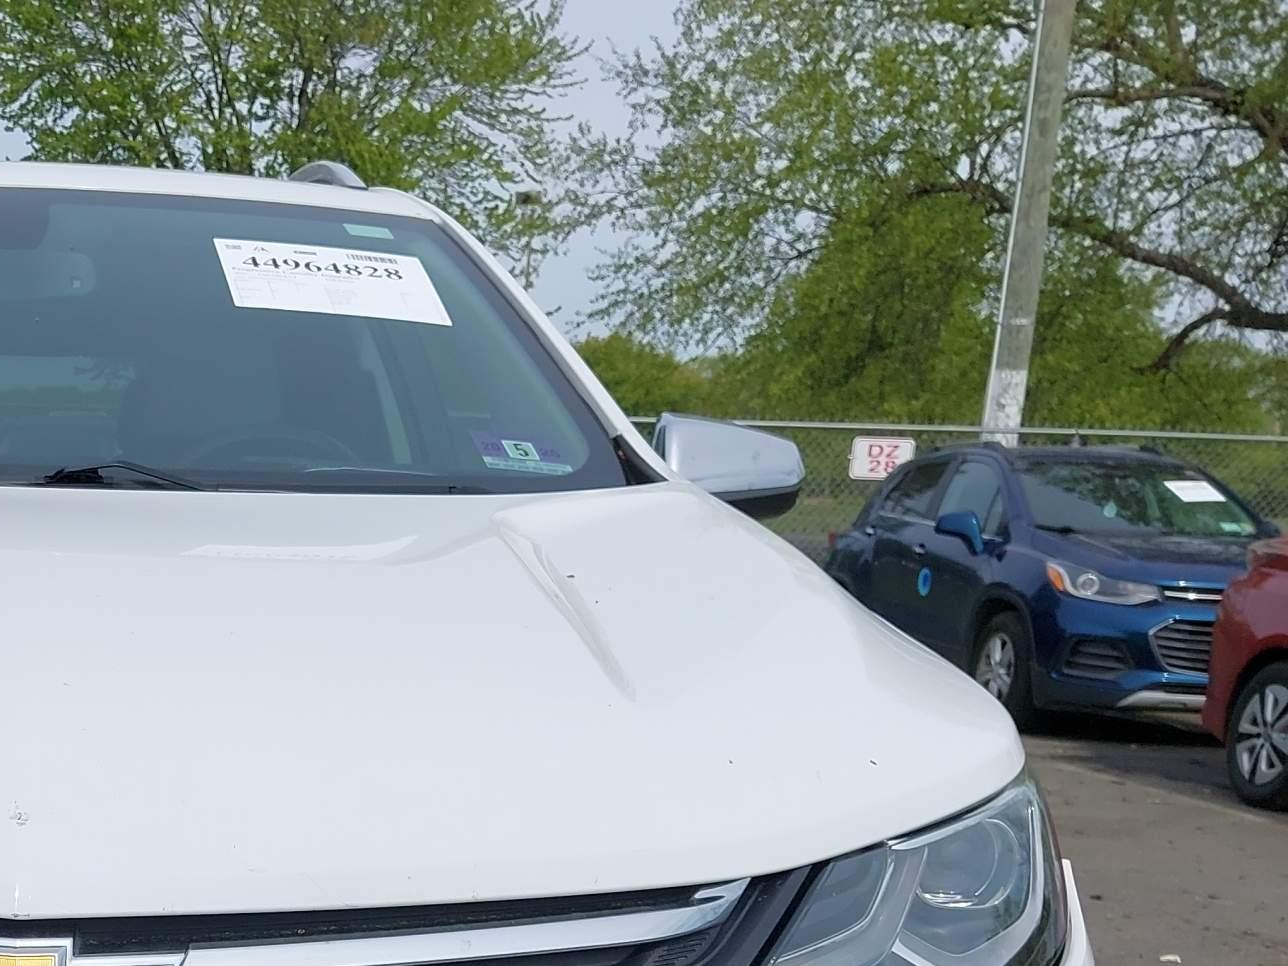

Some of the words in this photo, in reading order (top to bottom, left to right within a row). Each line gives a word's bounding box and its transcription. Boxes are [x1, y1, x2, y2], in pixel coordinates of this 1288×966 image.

[241, 255, 404, 281] 44964828
[513, 442, 530, 458] 5
[868, 444, 900, 459] DZ
[867, 459, 896, 474] 28
